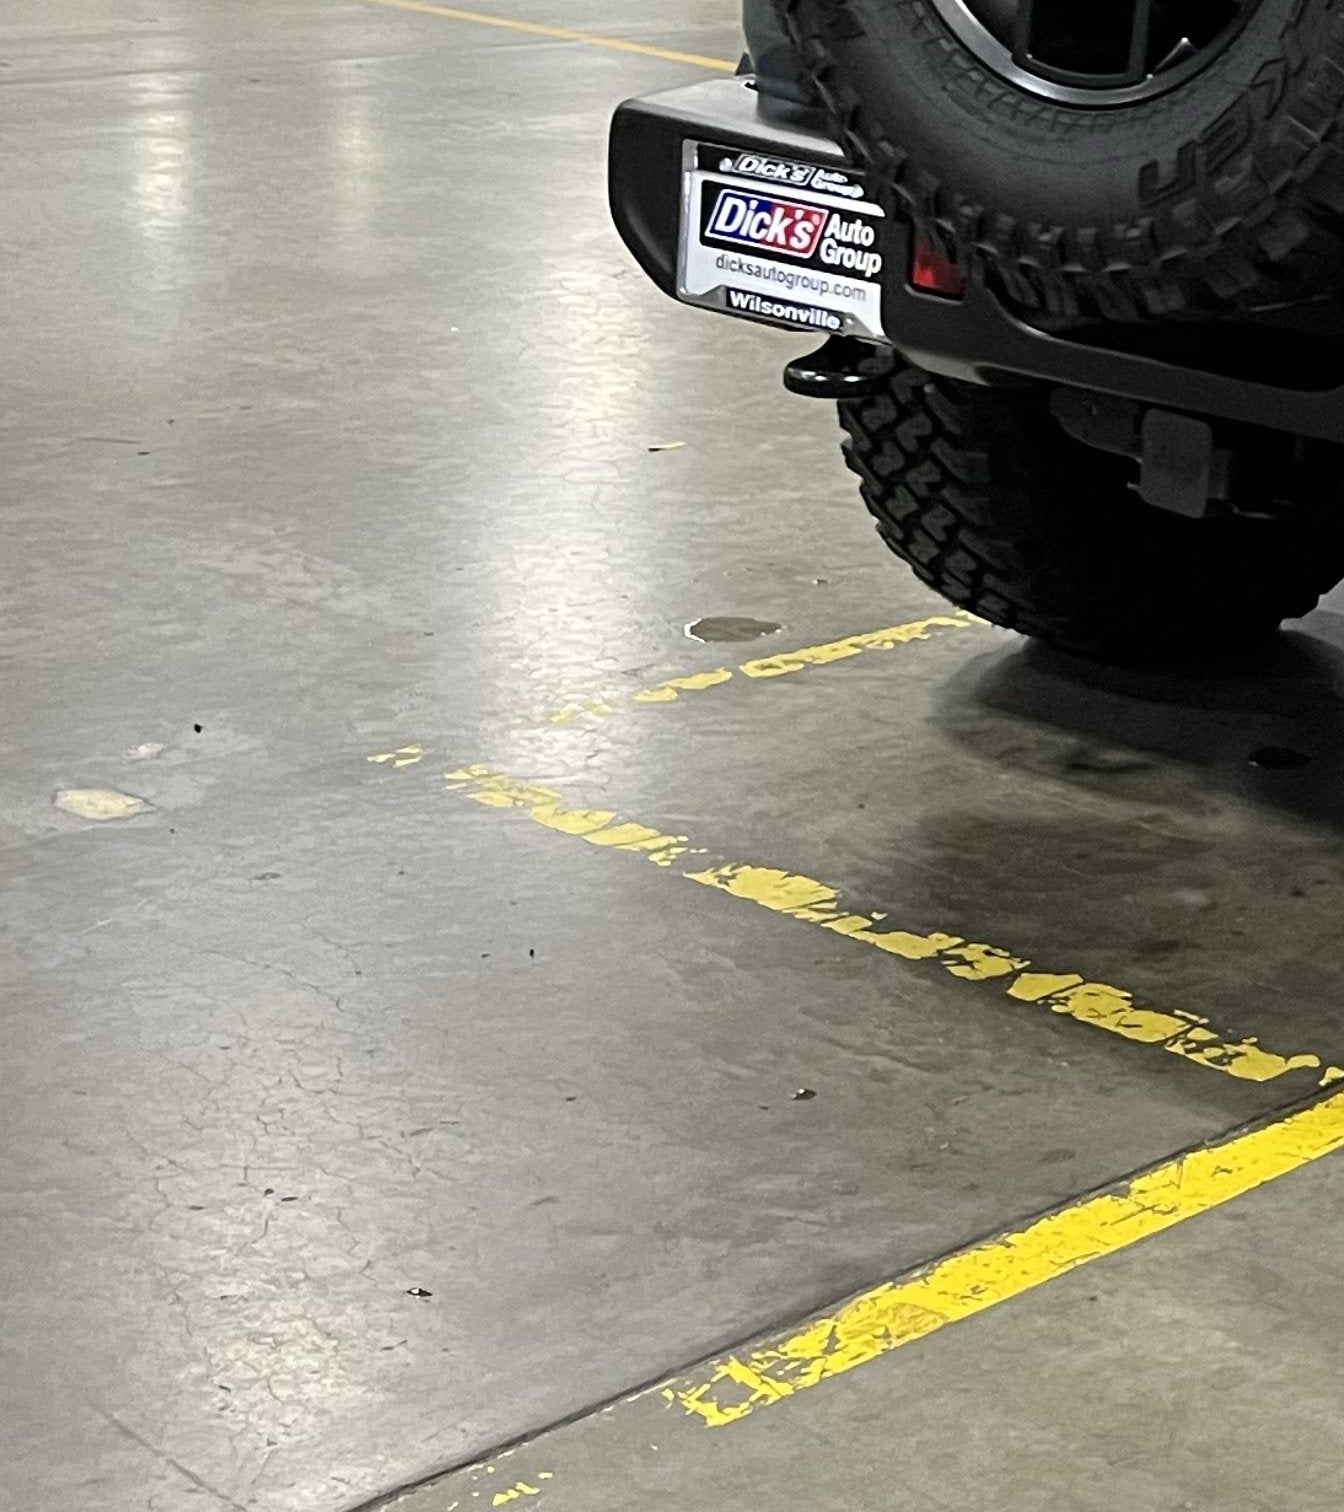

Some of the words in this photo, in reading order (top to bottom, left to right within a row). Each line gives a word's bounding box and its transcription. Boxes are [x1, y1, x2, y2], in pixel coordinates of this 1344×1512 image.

[738, 156, 810, 183] Dick's
[714, 196, 818, 253] Dick's
[824, 213, 875, 247] Auto
[715, 254, 867, 302] dicksautogroup.com
[820, 241, 882, 278] Group
[729, 290, 841, 330] Wilsonville
